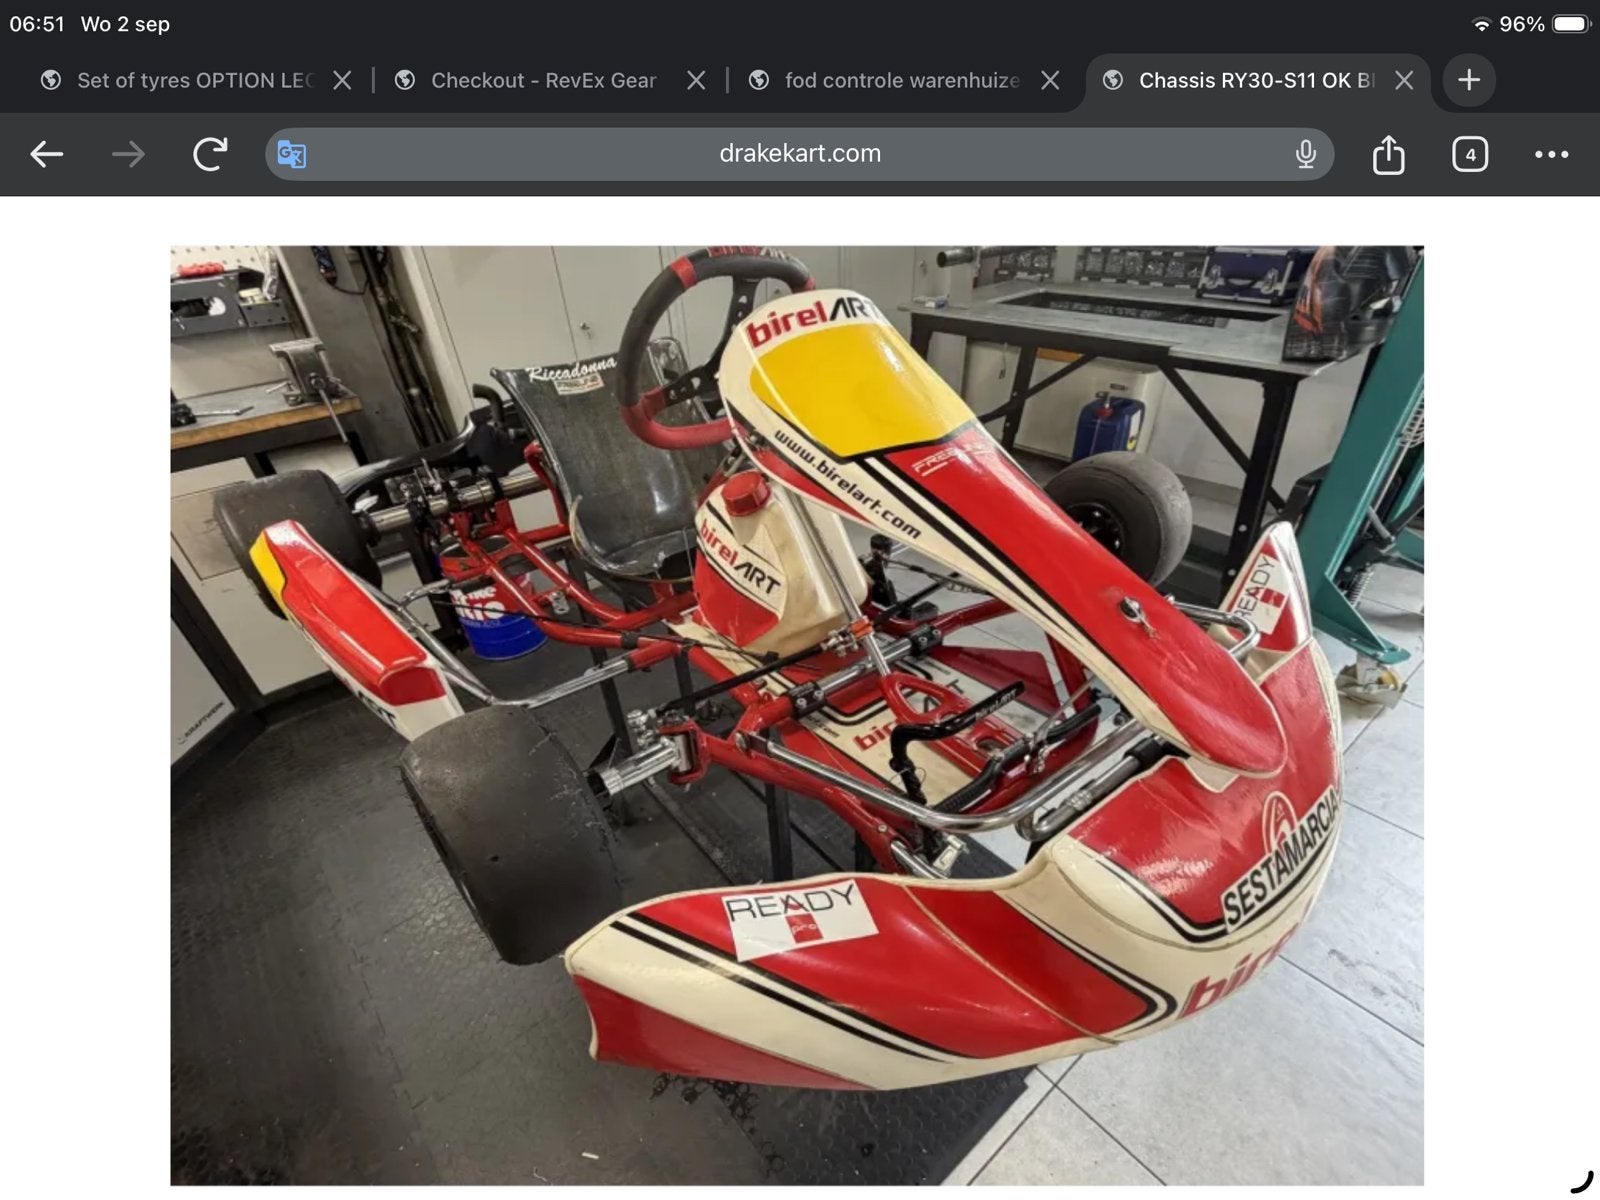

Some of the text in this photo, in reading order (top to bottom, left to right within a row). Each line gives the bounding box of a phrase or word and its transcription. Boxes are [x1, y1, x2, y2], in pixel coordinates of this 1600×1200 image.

[9, 15, 64, 33] 06:51
[80, 15, 171, 36] Wo 2 sep
[1499, 15, 1546, 33] 96%
[77, 71, 112, 89] Set
[115, 71, 136, 89] of
[139, 72, 191, 93] tyres
[194, 71, 276, 89] OPTION
[431, 71, 526, 89] Checkout
[546, 71, 605, 89] RevEx
[610, 71, 658, 89] Gear
[784, 71, 1021, 89] fod controle warenhuize
[1138, 71, 1217, 89] Chassis
[1221, 71, 1316, 89] RY30-S11
[1321, 71, 1353, 89] OK
[719, 142, 881, 163] drakekart.com
[1465, 147, 1477, 162] 4
[525, 357, 618, 382] Riccadonna
[774, 429, 922, 540] www.birelart.com
[700, 518, 782, 594] birelART
[1223, 787, 1340, 926] SESTAMARCIA
[725, 883, 855, 922] READY
[791, 922, 818, 936] pro
